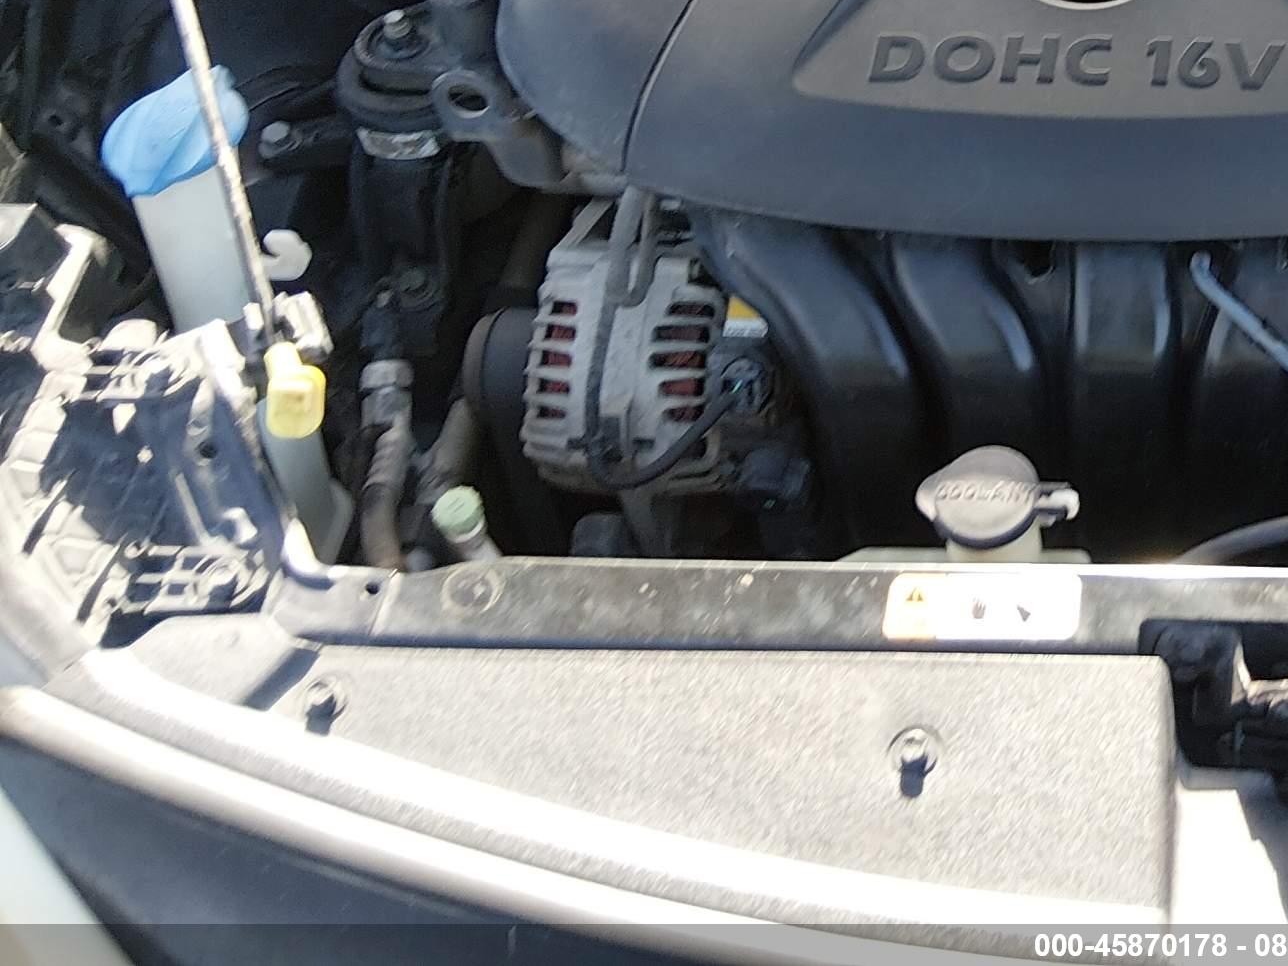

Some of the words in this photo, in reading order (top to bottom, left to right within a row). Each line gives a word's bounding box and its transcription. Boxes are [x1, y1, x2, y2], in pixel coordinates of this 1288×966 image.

[868, 33, 1112, 86] DOHC
[1146, 36, 1286, 92] 16V
[935, 480, 1039, 505] COOLANT
